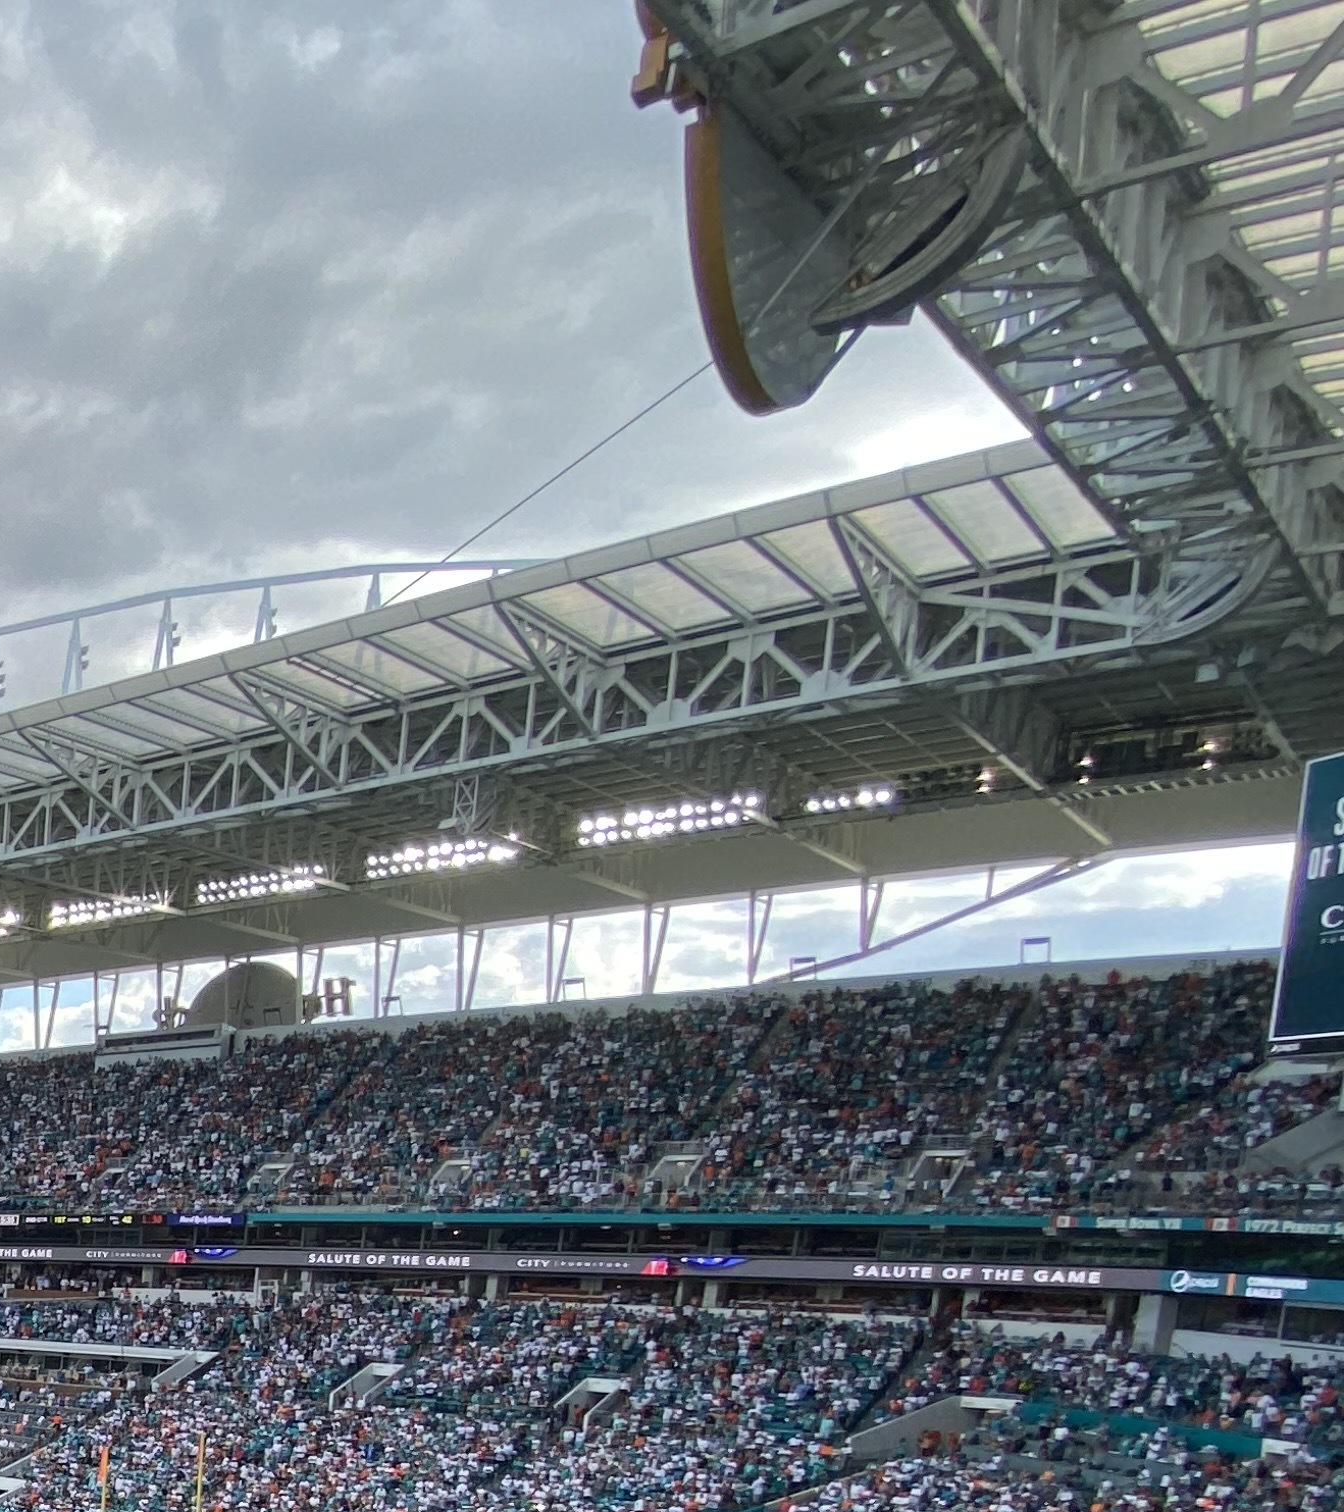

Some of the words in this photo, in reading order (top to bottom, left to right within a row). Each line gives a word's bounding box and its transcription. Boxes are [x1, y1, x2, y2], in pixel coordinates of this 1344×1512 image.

[1307, 846, 1333, 880] OF
[0, 1249, 18, 1257] THE
[21, 1249, 53, 1258] GAME
[308, 1253, 361, 1265] SALUTE
[366, 1254, 386, 1265] OF
[392, 1255, 420, 1265] THE
[425, 1256, 471, 1267] GAME
[517, 1258, 551, 1268] CITY
[853, 1265, 933, 1280] SALUTE
[942, 1266, 973, 1280] OF
[981, 1268, 1025, 1282] THE
[1033, 1270, 1101, 1284] GAME
